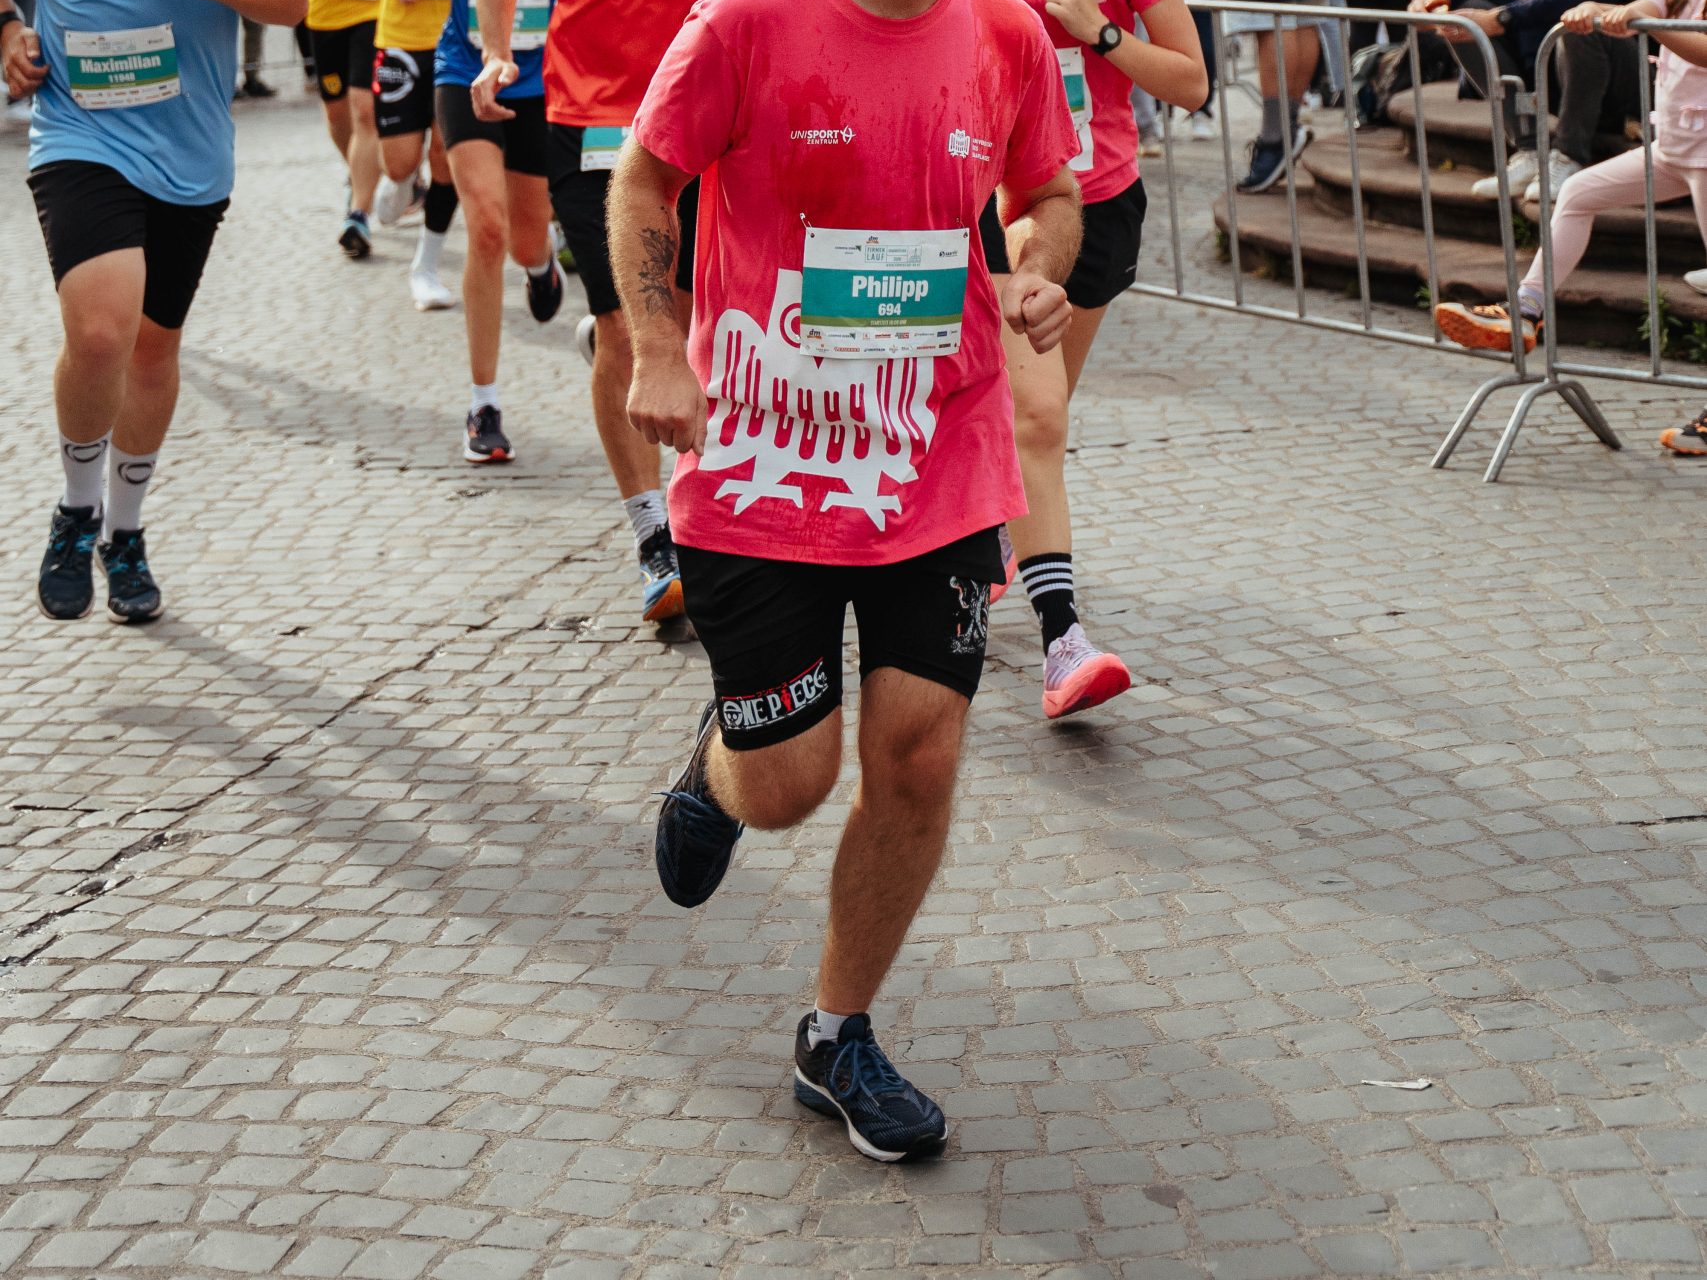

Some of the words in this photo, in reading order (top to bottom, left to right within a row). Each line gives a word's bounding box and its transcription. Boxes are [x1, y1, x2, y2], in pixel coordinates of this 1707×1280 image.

[80, 55, 161, 73] Maximilian
[790, 129, 839, 140] UNISPORT
[852, 275, 929, 302] Philipp
[878, 303, 901, 317] 694
[723, 698, 768, 729] ONE
